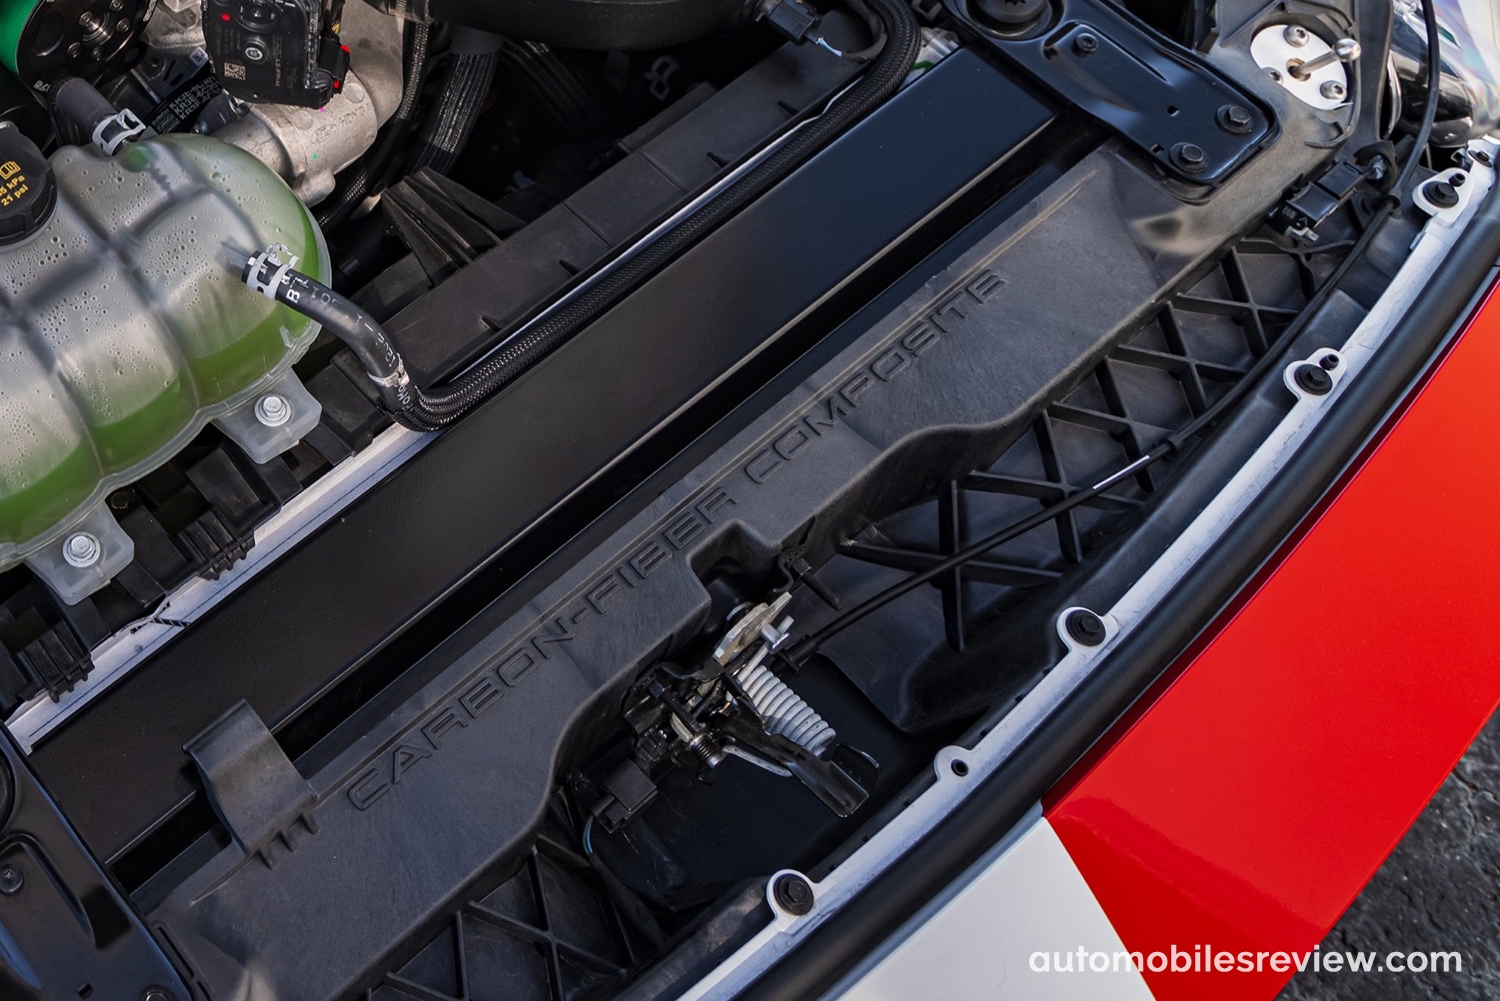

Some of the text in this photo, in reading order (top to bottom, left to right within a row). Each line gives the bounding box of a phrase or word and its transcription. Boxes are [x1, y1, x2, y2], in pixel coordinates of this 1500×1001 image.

[6, 175, 26, 190] kPa
[1, 184, 29, 206] 21 psi
[346, 269, 1006, 811] CARBON-FIBER COMPOSITE
